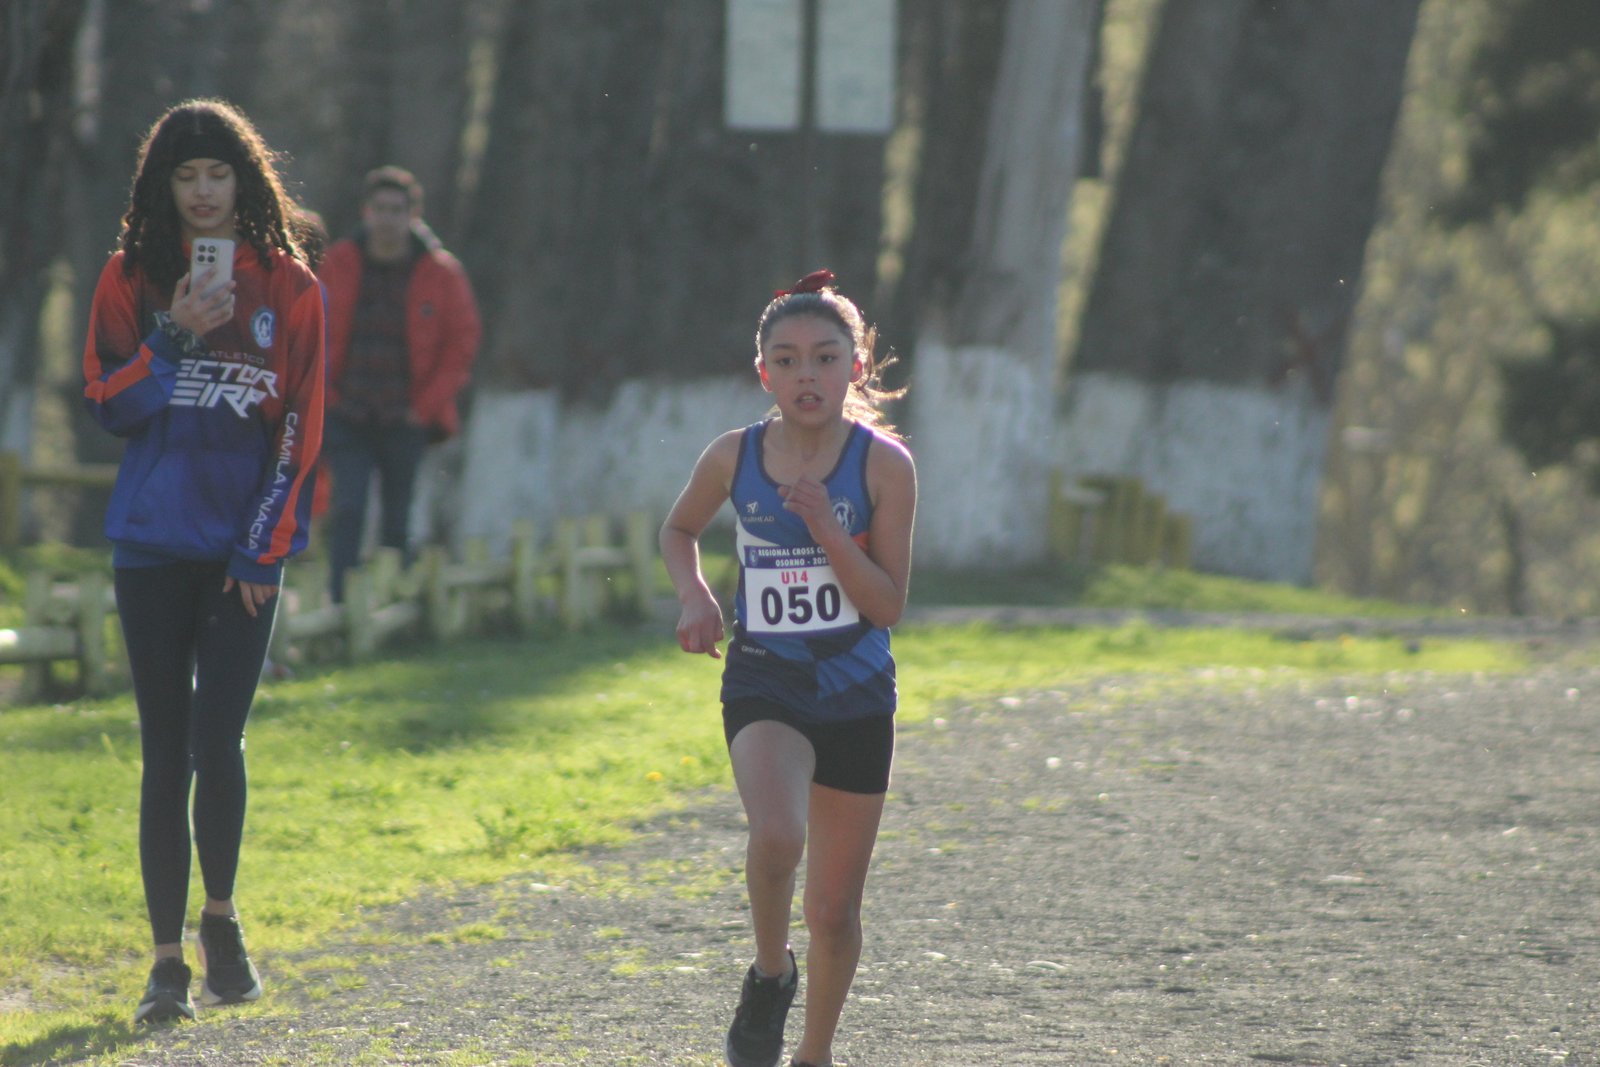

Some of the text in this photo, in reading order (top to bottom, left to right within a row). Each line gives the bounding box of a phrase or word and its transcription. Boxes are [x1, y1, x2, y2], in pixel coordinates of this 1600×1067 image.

[176, 359, 278, 398] ECTOR
[168, 381, 268, 418] EIRA
[274, 412, 298, 484] CAMILA
[758, 548, 790, 556] REGIONAL
[792, 547, 815, 556] CROSS
[775, 558, 805, 567] OSORNO
[813, 557, 827, 566] 202
[781, 570, 808, 585] U14
[761, 583, 841, 625] 050
